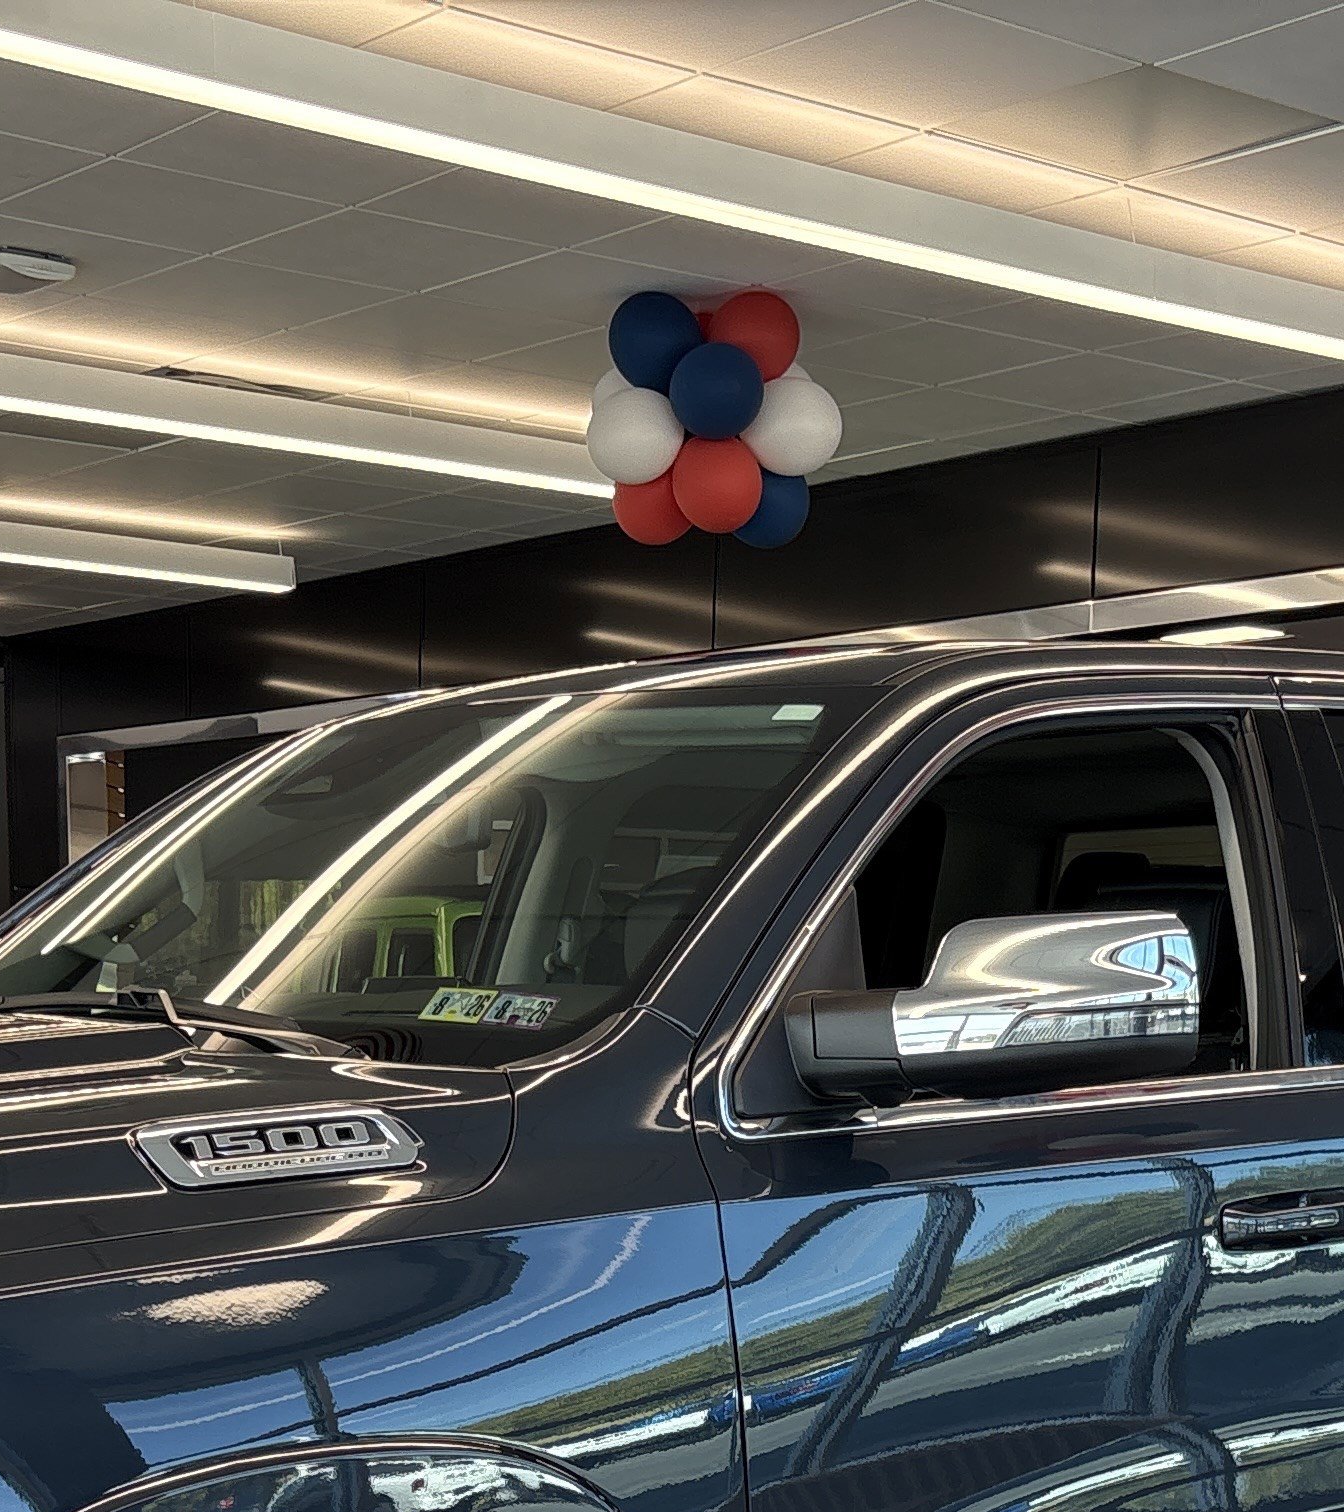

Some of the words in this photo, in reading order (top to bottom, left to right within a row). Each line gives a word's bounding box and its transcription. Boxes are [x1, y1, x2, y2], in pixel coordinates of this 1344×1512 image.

[432, 996, 450, 1016] 8
[463, 994, 492, 1018] 26
[493, 1000, 513, 1020] 8
[527, 1000, 554, 1024] 26
[180, 1121, 371, 1160] 1500
